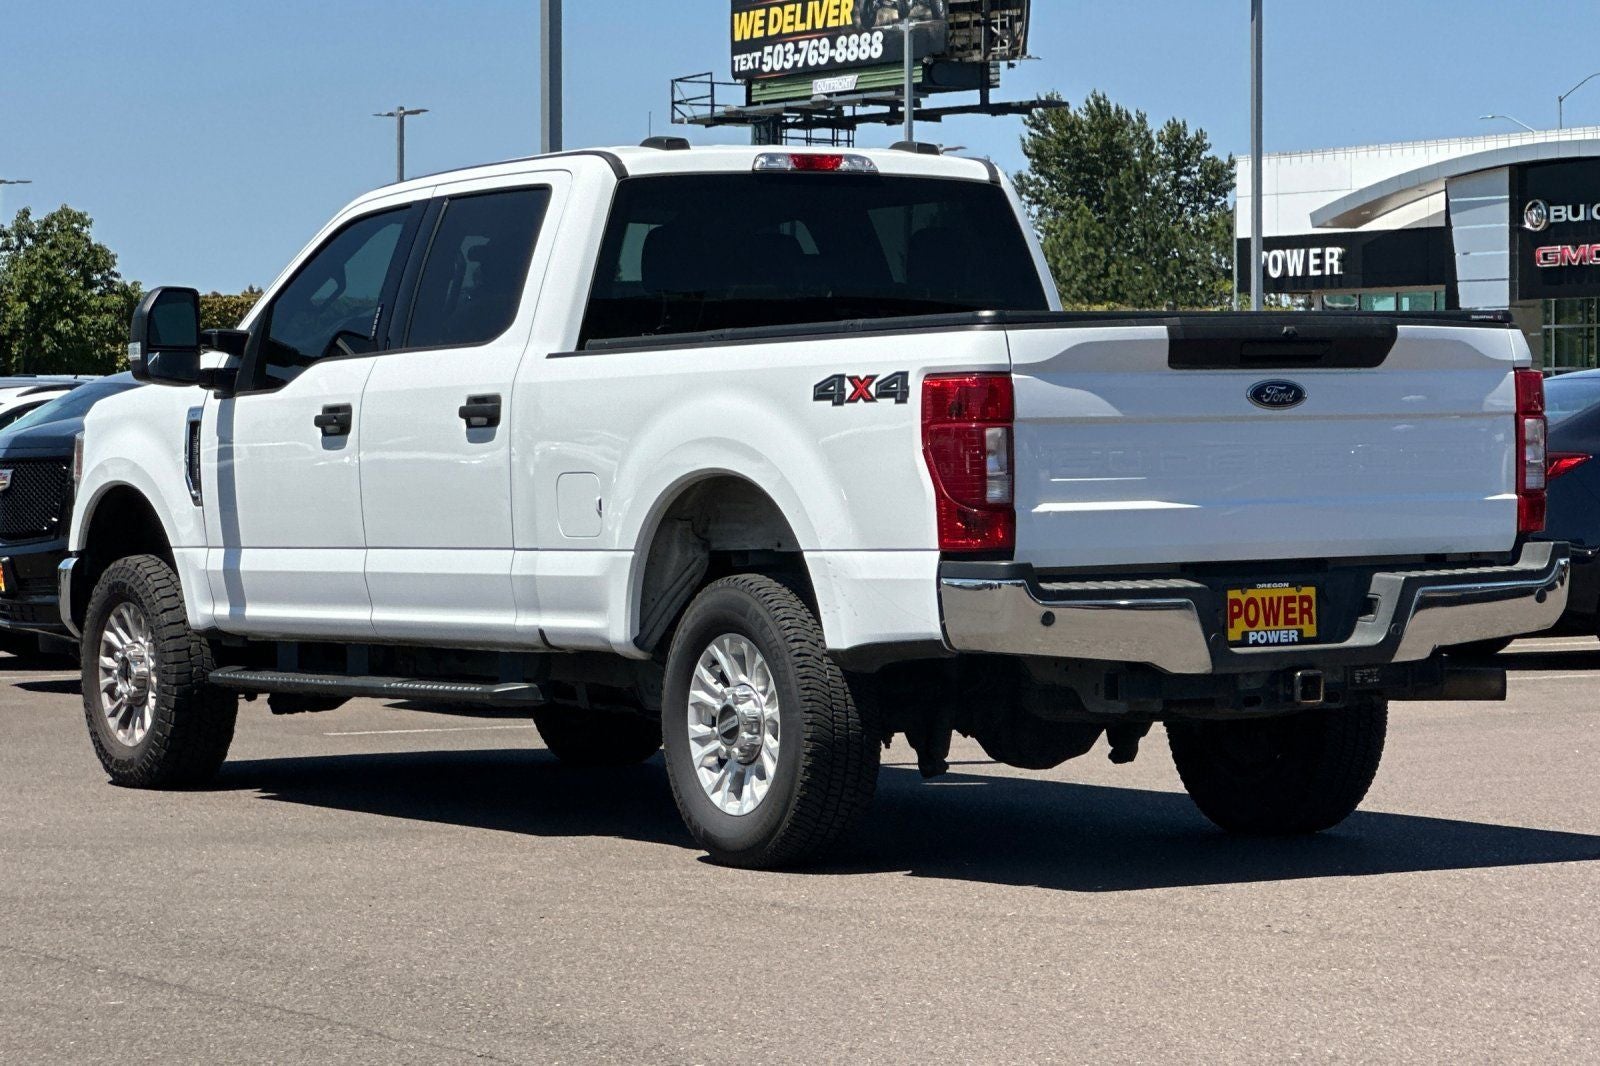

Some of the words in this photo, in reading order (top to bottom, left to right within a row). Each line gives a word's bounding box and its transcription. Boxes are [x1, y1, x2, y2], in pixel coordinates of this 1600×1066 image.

[733, 9, 766, 42] WE
[767, 0, 855, 36] DELIVER
[733, 51, 762, 72] TEXT
[761, 31, 884, 73] 503-769-8888
[1261, 385, 1295, 402] Ford
[1228, 594, 1315, 629] POWER
[1248, 630, 1299, 644] POWER
